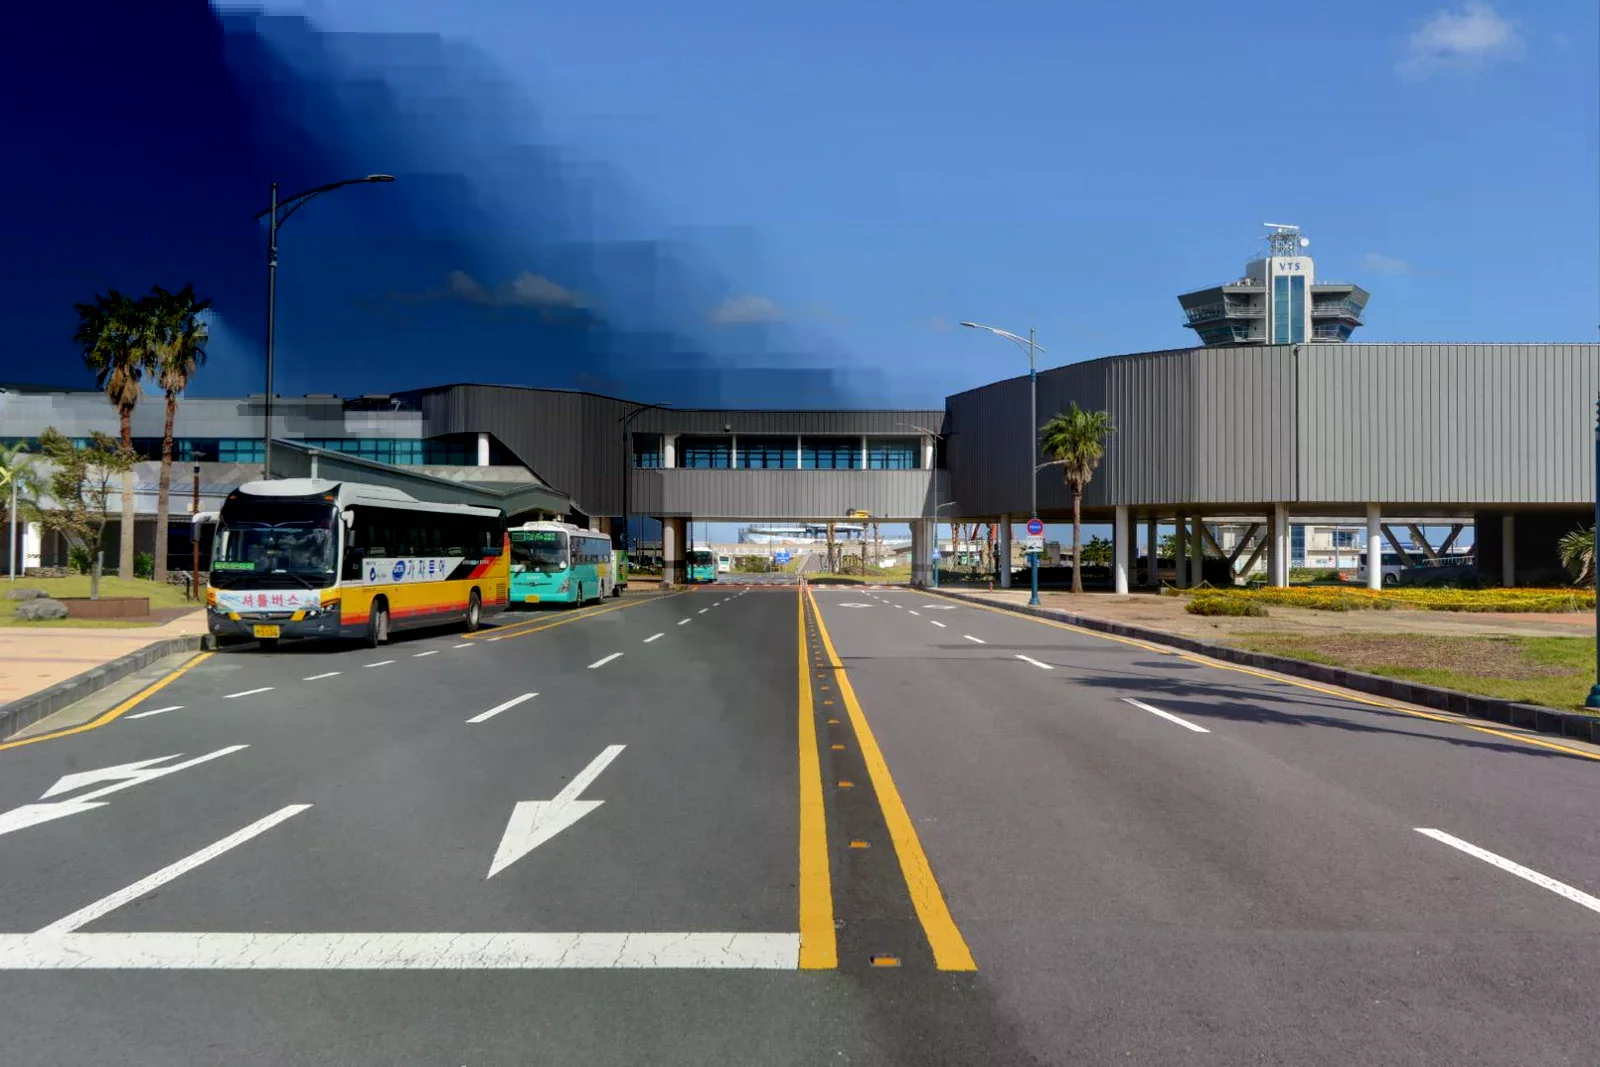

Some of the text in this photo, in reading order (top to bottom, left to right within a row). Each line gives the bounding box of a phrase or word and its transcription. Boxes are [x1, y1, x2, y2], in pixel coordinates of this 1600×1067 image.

[1279, 262, 1300, 270] VTS
[407, 559, 445, 580] 가자투어
[242, 593, 300, 608] 셔틀버스
